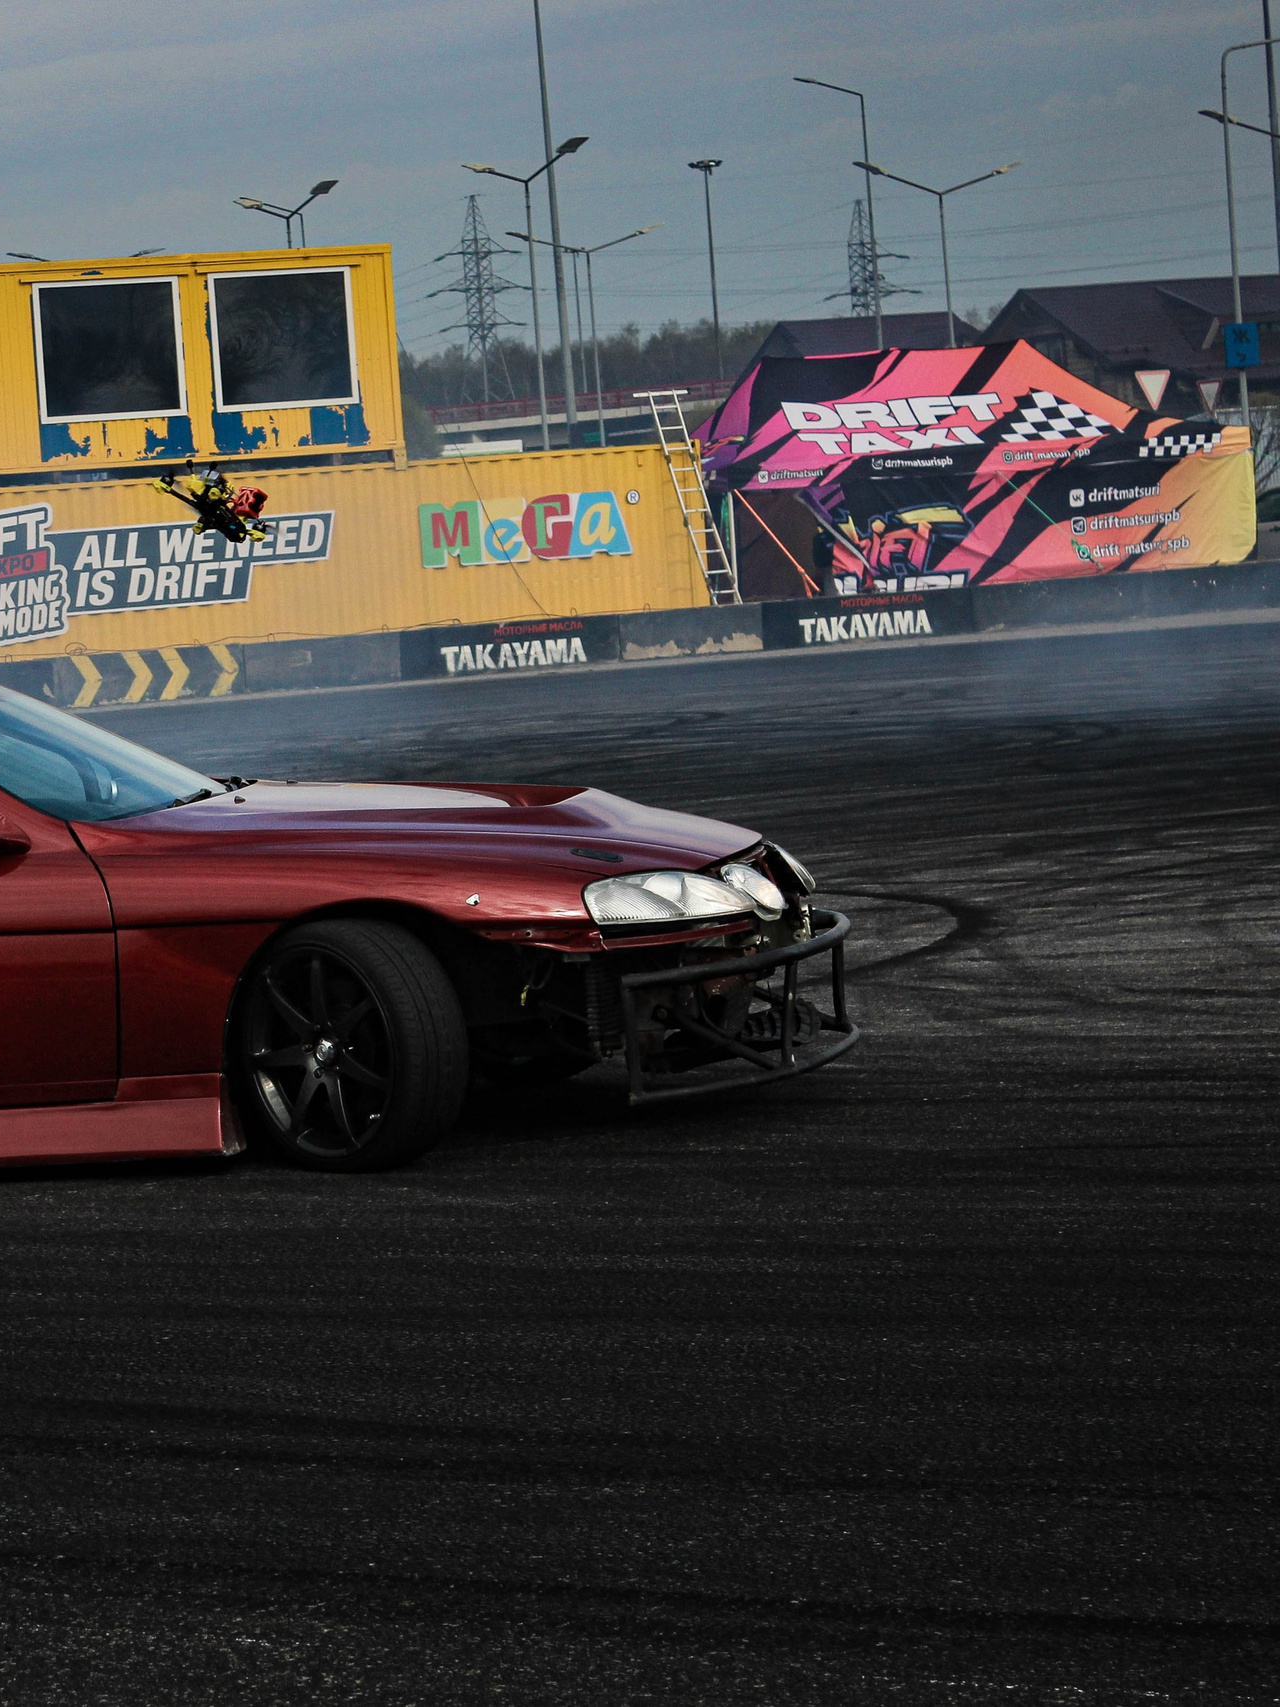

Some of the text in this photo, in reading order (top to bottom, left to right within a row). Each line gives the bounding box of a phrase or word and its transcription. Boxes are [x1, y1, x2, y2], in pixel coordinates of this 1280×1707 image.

[781, 392, 1002, 430] DRIFT
[796, 426, 985, 455] TAXI
[1088, 483, 1160, 503] driftmatsuri
[1089, 509, 1181, 531] driftmatsurispb
[73, 532, 147, 571] ALL
[158, 528, 216, 563] WE
[75, 560, 243, 607] IS DRIFT
[798, 609, 933, 644] TAKAYAMA
[440, 637, 587, 674] TAKAYAMA
